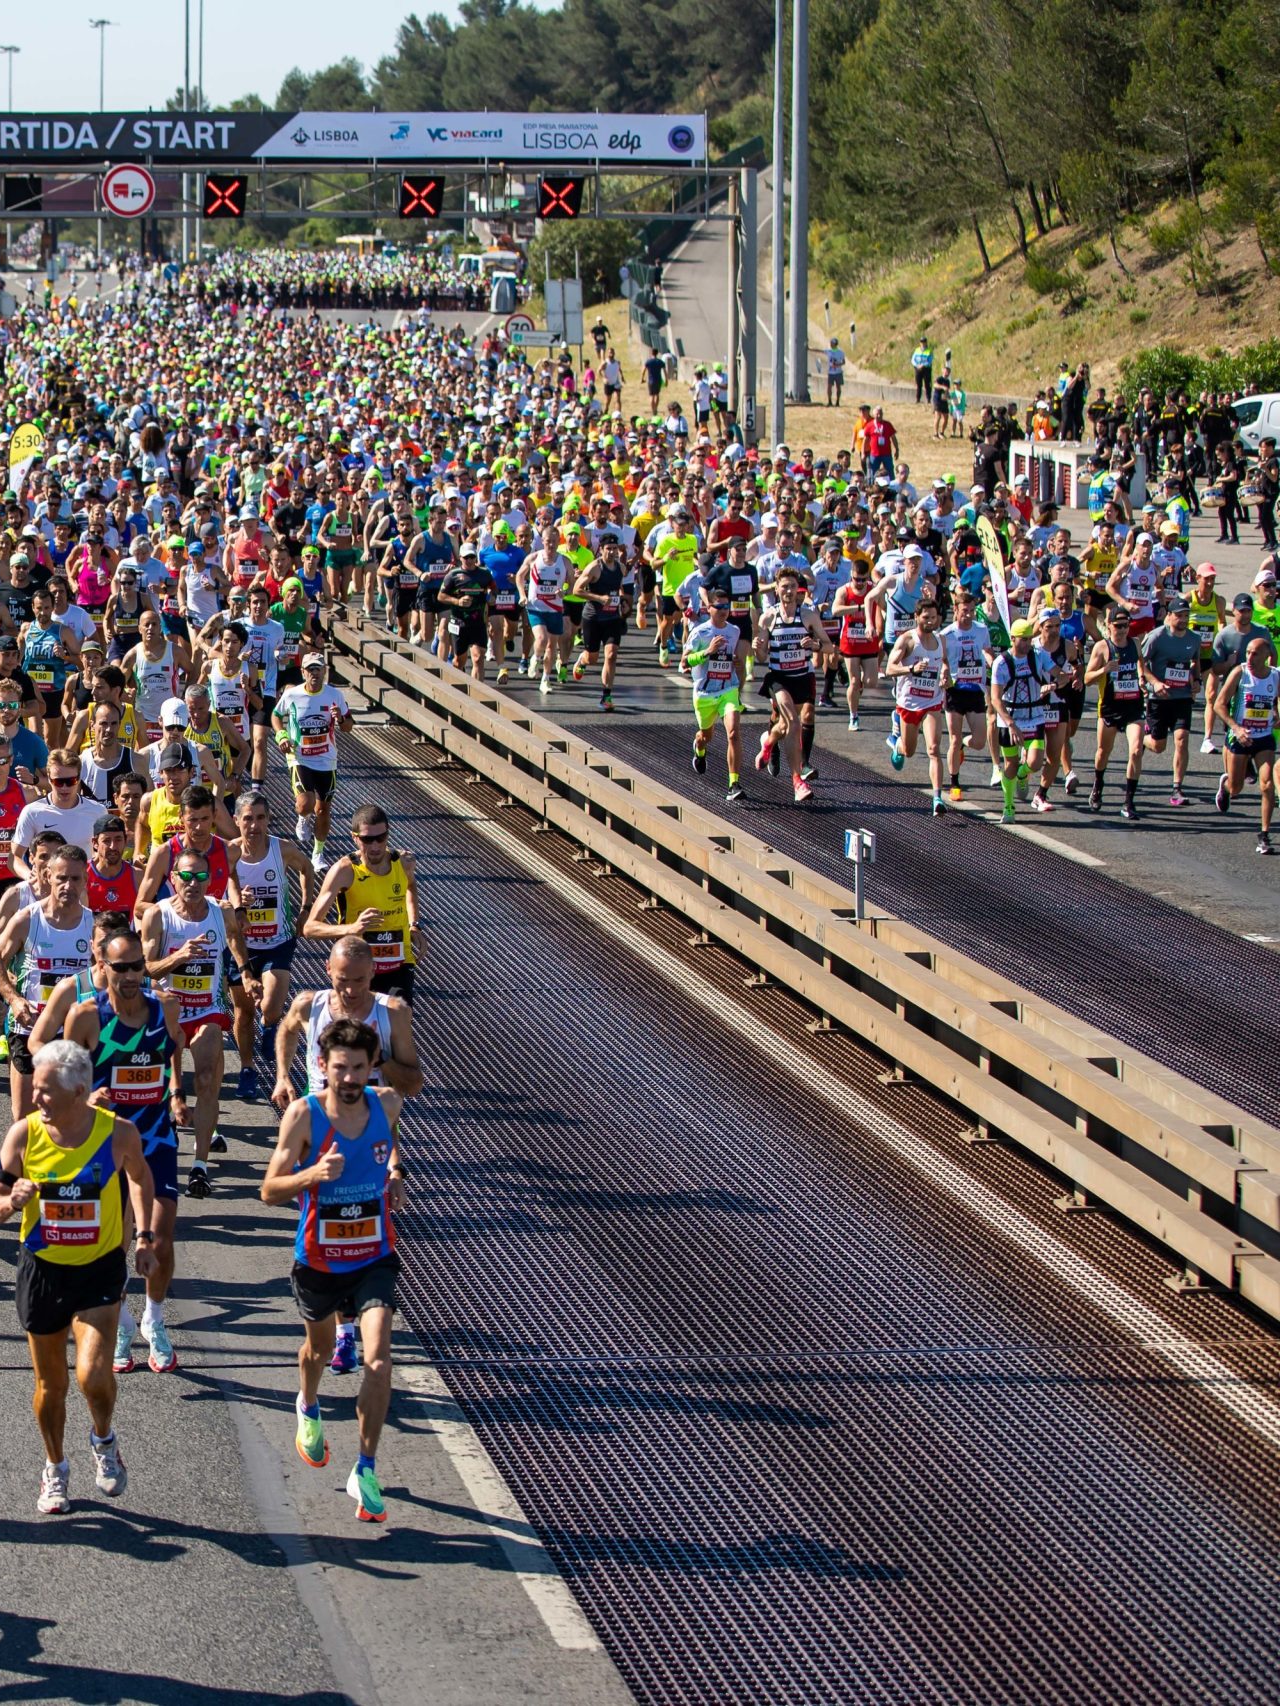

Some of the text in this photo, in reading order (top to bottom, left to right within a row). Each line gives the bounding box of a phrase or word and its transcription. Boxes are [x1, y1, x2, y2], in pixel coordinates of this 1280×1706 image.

[132, 120, 236, 150] START
[314, 130, 359, 142] LISBOA
[426, 128, 502, 144] VC viacard
[523, 132, 598, 150] LISBOA
[608, 129, 642, 155] edp
[14, 434, 41, 449] 5:30
[784, 650, 802, 659] 6361
[962, 667, 979, 675] 4314
[248, 911, 267, 920] 191
[377, 932, 392, 942] edp
[374, 946, 394, 956] 354
[185, 964, 202, 974] edp
[181, 978, 203, 989] 195
[131, 1052, 151, 1065] edp
[127, 1070, 152, 1082] 368
[131, 1091, 158, 1100] SEASIDE
[58, 1183, 82, 1198] edp
[56, 1204, 85, 1219] 341
[340, 1204, 363, 1218] edp
[337, 1223, 365, 1237] 317
[344, 1246, 375, 1255] SEASIDE
